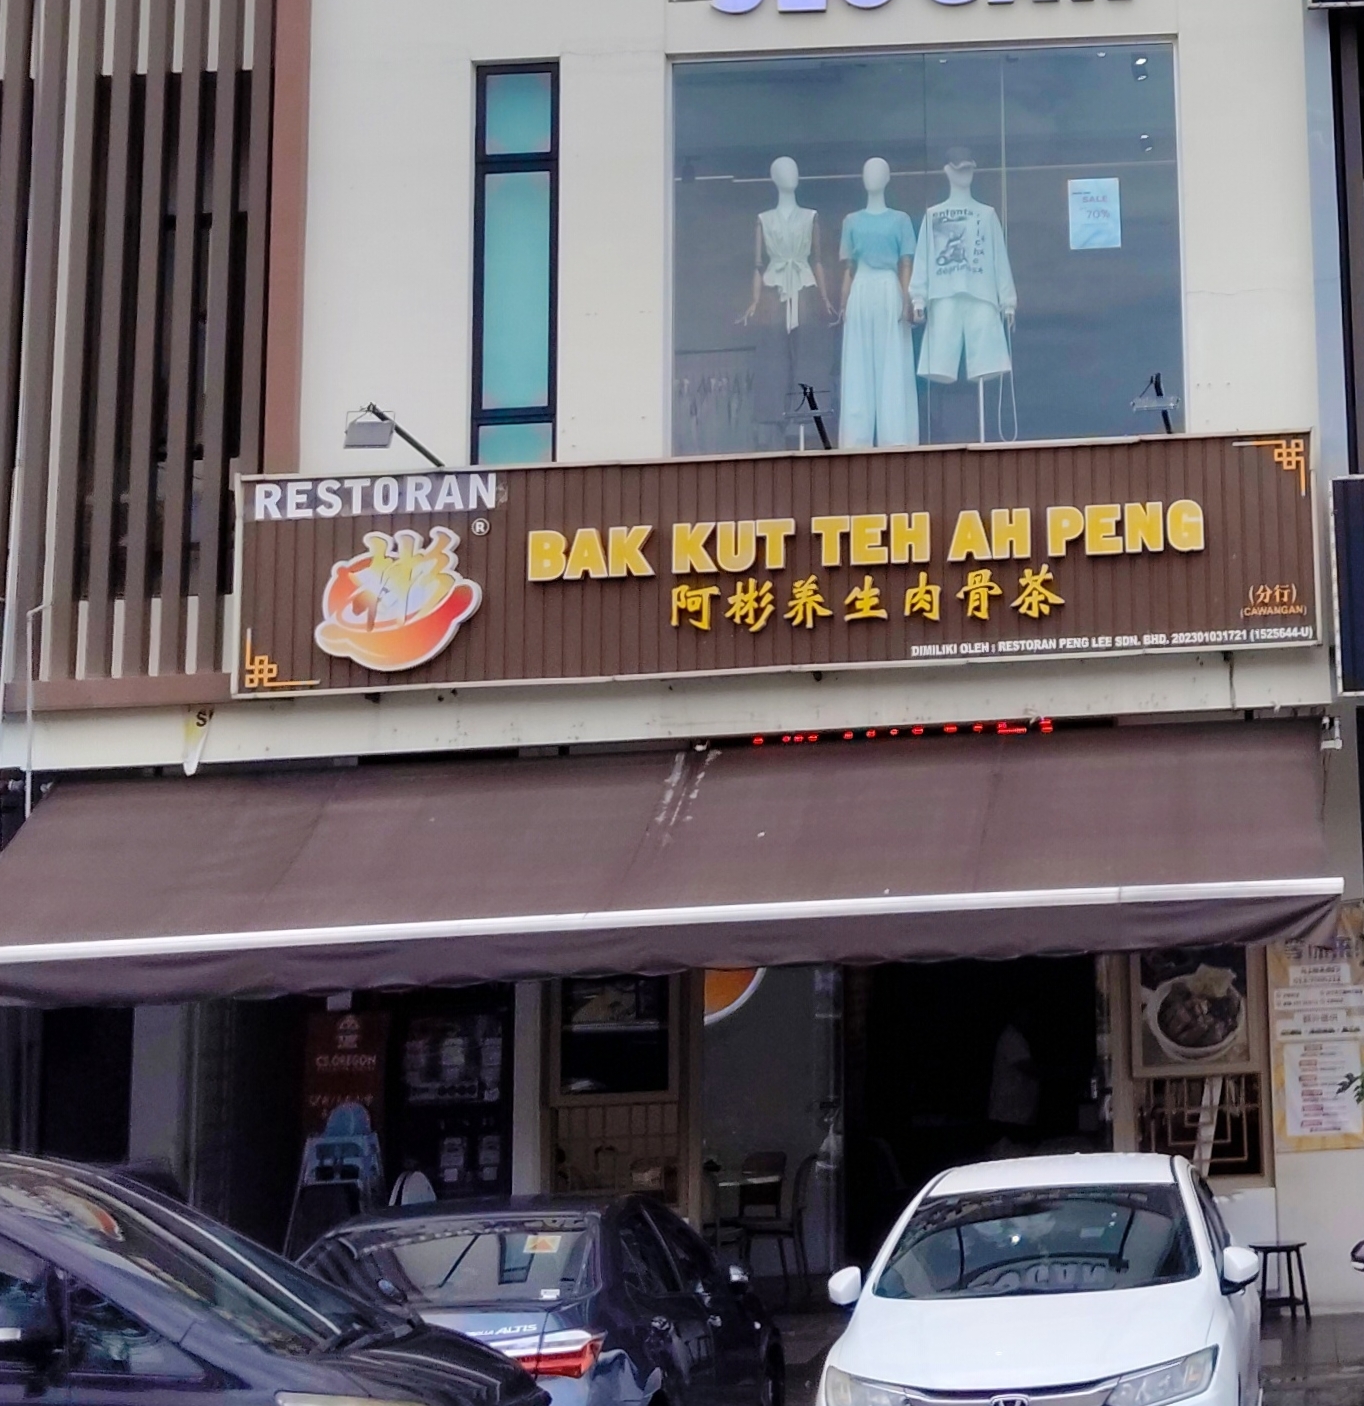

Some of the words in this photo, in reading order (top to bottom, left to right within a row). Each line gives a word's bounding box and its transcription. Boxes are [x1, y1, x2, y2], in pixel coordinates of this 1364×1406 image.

[254, 472, 498, 521] RESTORAN
[527, 525, 656, 583] BAK
[671, 517, 796, 575] KUT
[811, 512, 930, 568] TEH
[946, 507, 1031, 562] AH
[1046, 498, 1205, 558] PENG
[670, 563, 1065, 633] 阿彬养生肉骨茶
[1240, 604, 1308, 619] (CAWANGAN)
[911, 643, 958, 657] DIMILIKI
[959, 641, 990, 654] OLEH
[998, 638, 1057, 652] RESTORAN
[1058, 636, 1090, 649] PENG
[1091, 636, 1112, 647] LEE
[1114, 634, 1141, 647] SDN.
[1143, 632, 1170, 646] BHD.
[494, 1323, 538, 1336] ALTIS
